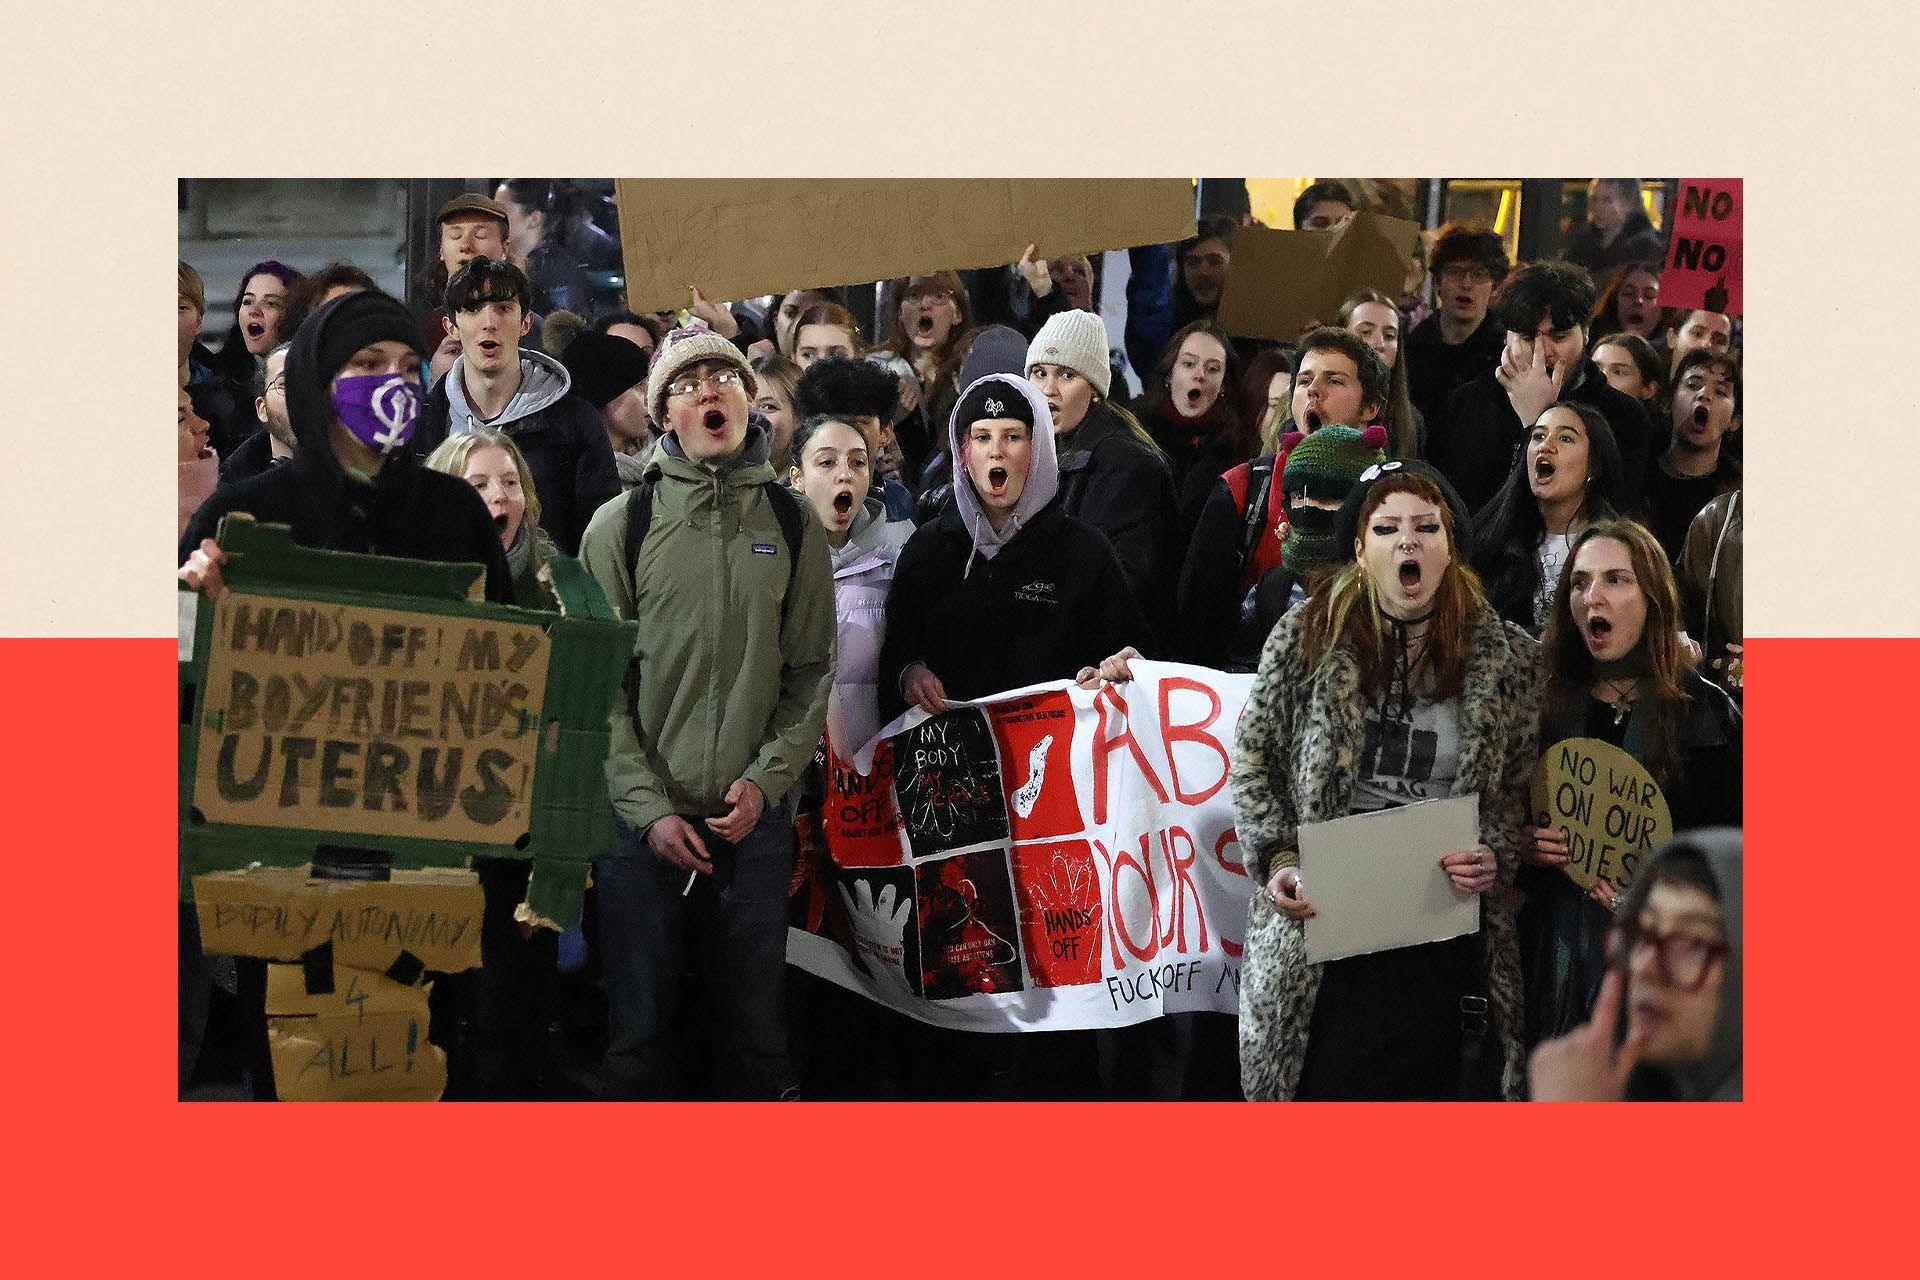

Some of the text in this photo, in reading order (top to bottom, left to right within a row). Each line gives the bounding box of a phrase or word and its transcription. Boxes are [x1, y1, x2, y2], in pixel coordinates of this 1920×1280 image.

[1684, 187, 1733, 220] NO
[1673, 238, 1725, 272] NO
[231, 603, 343, 657] HANDS
[456, 628, 541, 672] MY
[920, 721, 949, 745] MY
[1093, 677, 1247, 825] AB
[914, 743, 961, 769] BODY
[1561, 746, 1656, 809] NO WAR
[1556, 782, 1657, 849] ON OUR
[329, 905, 471, 947] AUTONOMY
[1045, 908, 1091, 936] HANDS
[1053, 936, 1082, 961] OFF
[345, 974, 369, 1028] 4
[299, 1018, 418, 1079] ALL!
